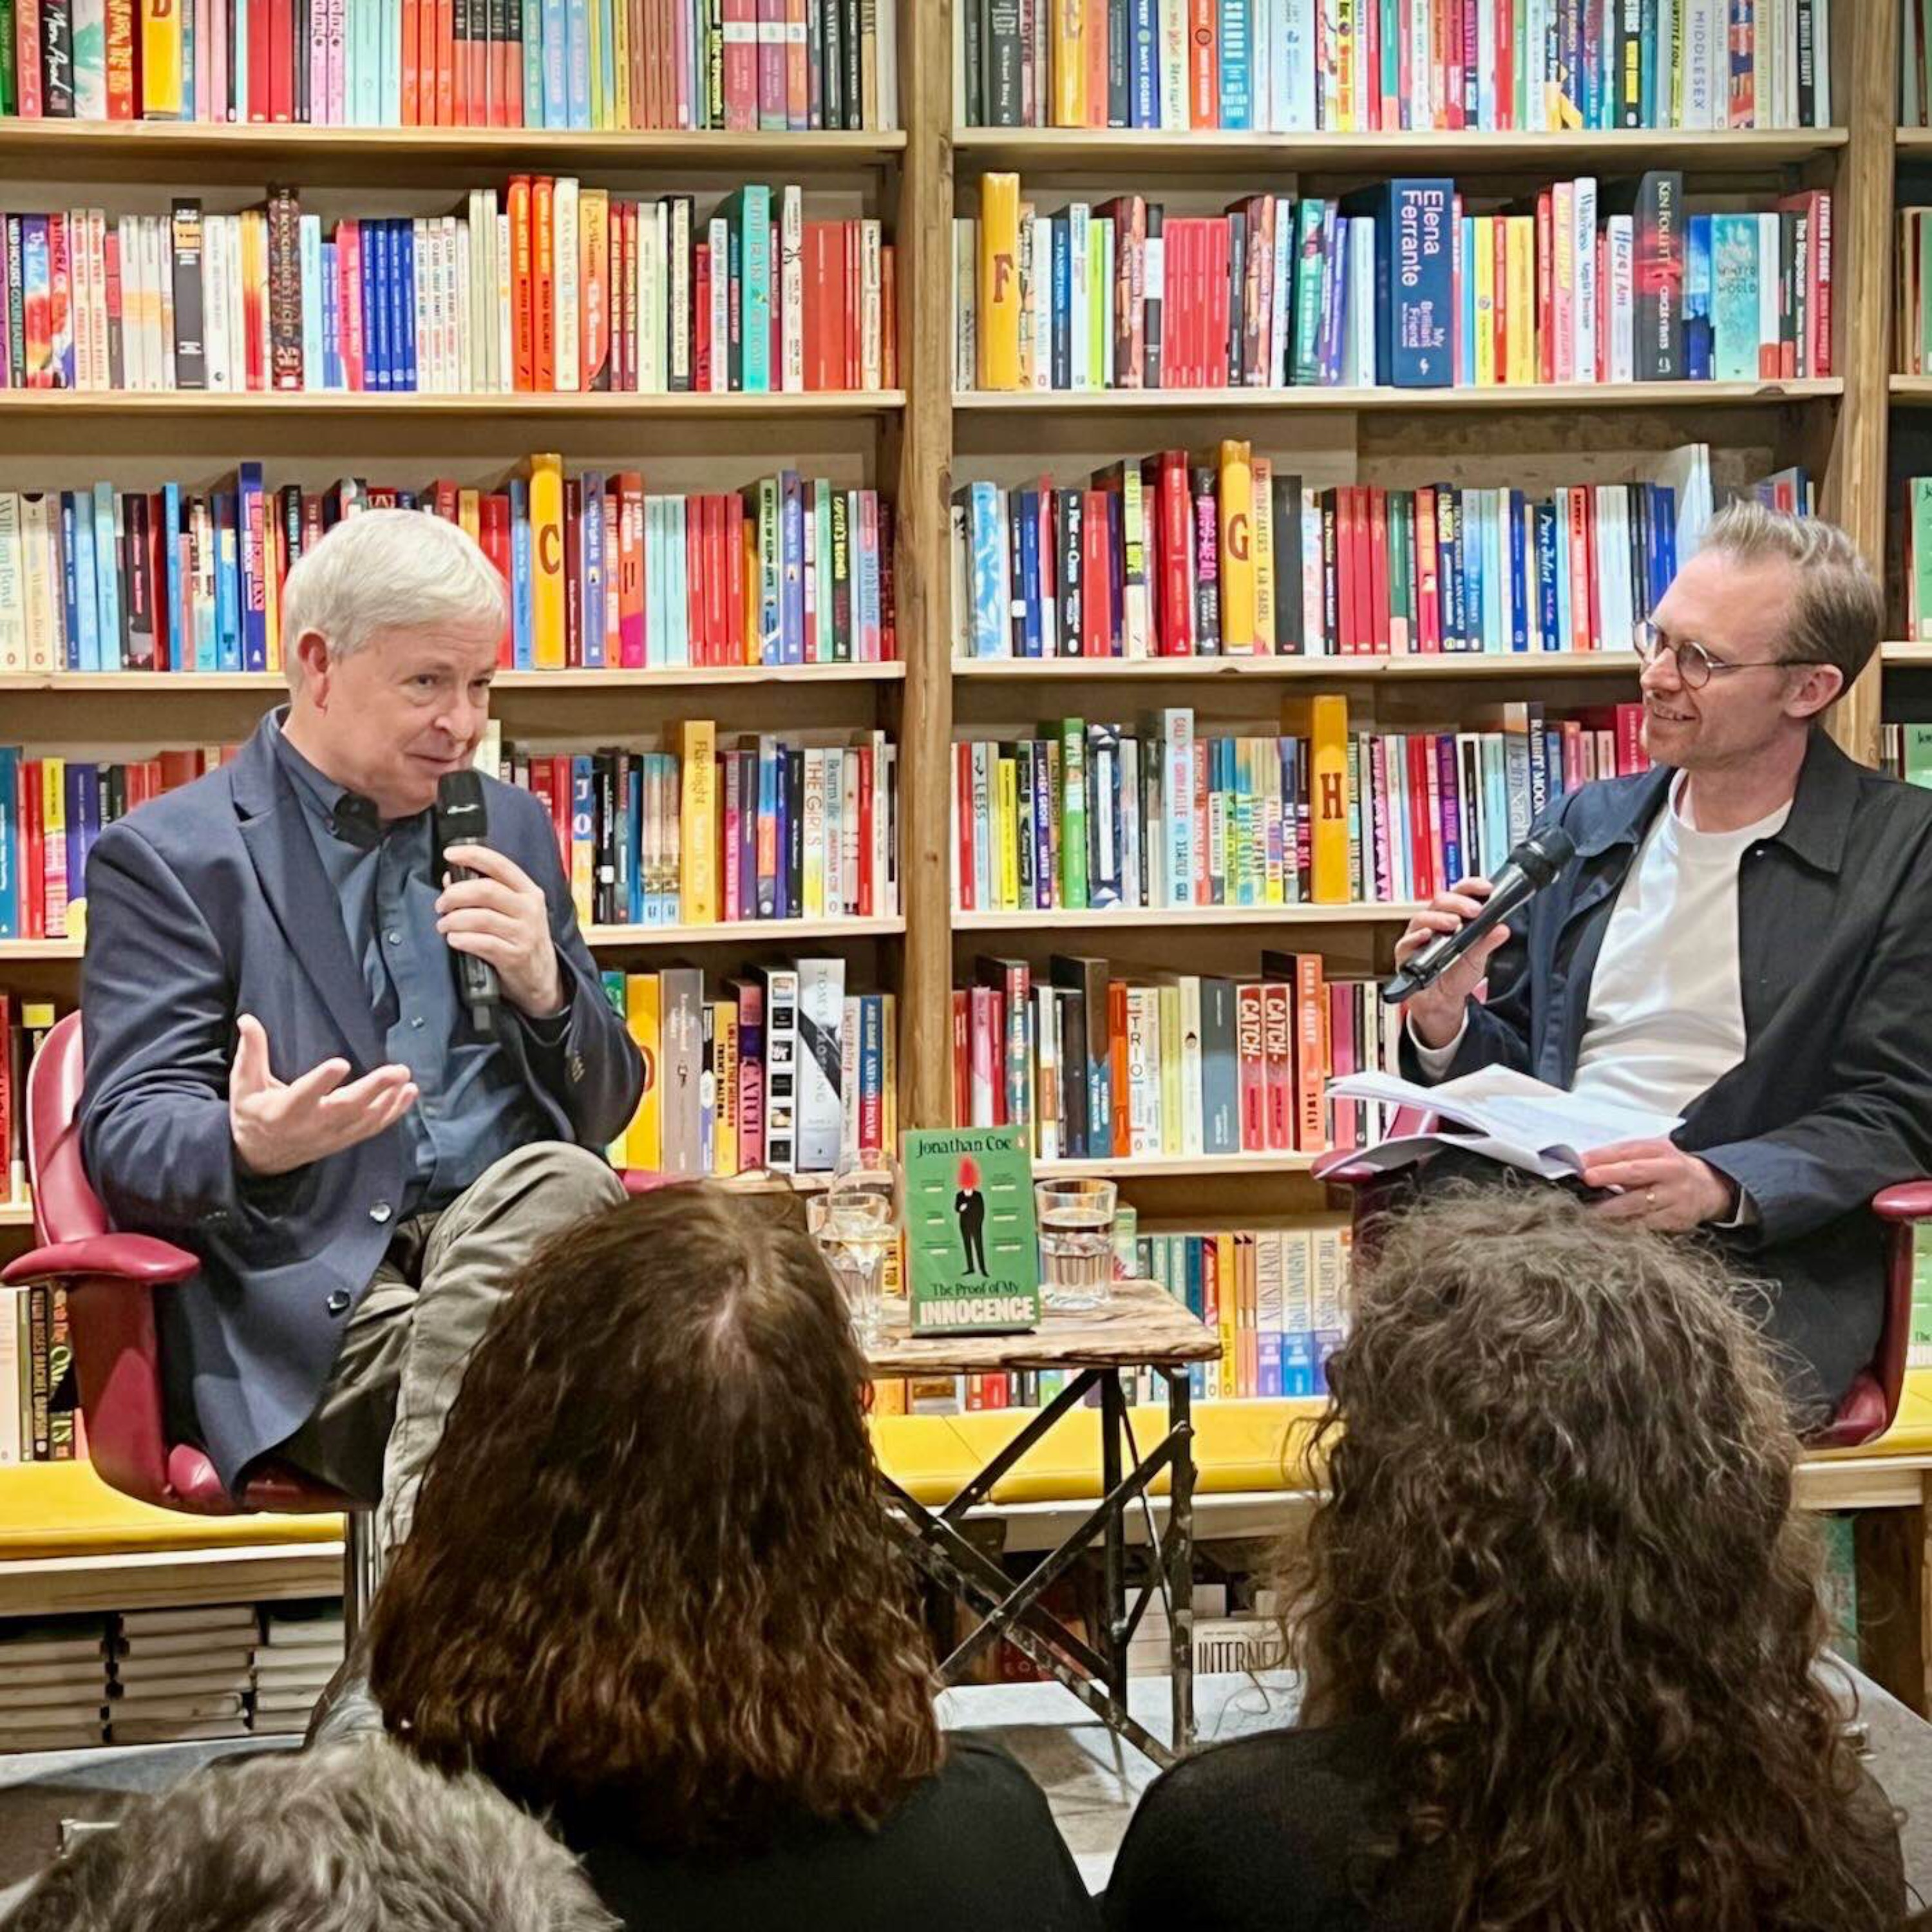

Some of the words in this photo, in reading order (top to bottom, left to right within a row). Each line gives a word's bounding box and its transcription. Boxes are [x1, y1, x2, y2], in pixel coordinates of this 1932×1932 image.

[1139, 45, 1149, 73] DAVE
[1694, 10, 1705, 109] MIDDLESEX
[1658, 182, 1671, 208] KEN
[1401, 190, 1421, 287] Ferrante
[1422, 190, 1443, 255] Elena
[1819, 196, 1830, 238] FATHER
[992, 254, 1013, 303] F
[1819, 241, 1830, 282] FIGURE
[1408, 307, 1420, 348] Friend
[1419, 301, 1432, 348] Brilliant
[1432, 328, 1444, 347] My
[539, 524, 560, 575] C
[1227, 513, 1248, 561] G
[1531, 719, 1544, 769] RABBIT
[691, 741, 707, 804] Flashlight
[807, 760, 822, 790] THE
[976, 782, 985, 820] LESS
[1320, 772, 1343, 819] H
[807, 796, 822, 846] GIRLS
[1283, 819, 1296, 848] LAST
[1298, 823, 1309, 840] THE
[1130, 1017, 1142, 1077] TRIO
[1242, 998, 1260, 1063] CATCH-
[1267, 998, 1286, 1062] CATCH-
[744, 1063, 761, 1135] CATCH
[1307, 1093, 1318, 1131] SWEAT
[916, 1137, 983, 1157] Jonathan
[985, 1135, 1012, 1151] Coe
[931, 1283, 952, 1296] The
[956, 1282, 987, 1296] Proof
[988, 1281, 999, 1295] of
[999, 1280, 1019, 1296] My
[919, 1296, 1036, 1326] INNOCENCE
[33, 1321, 46, 1355] ROSES
[33, 1396, 47, 1439] DAWSON
